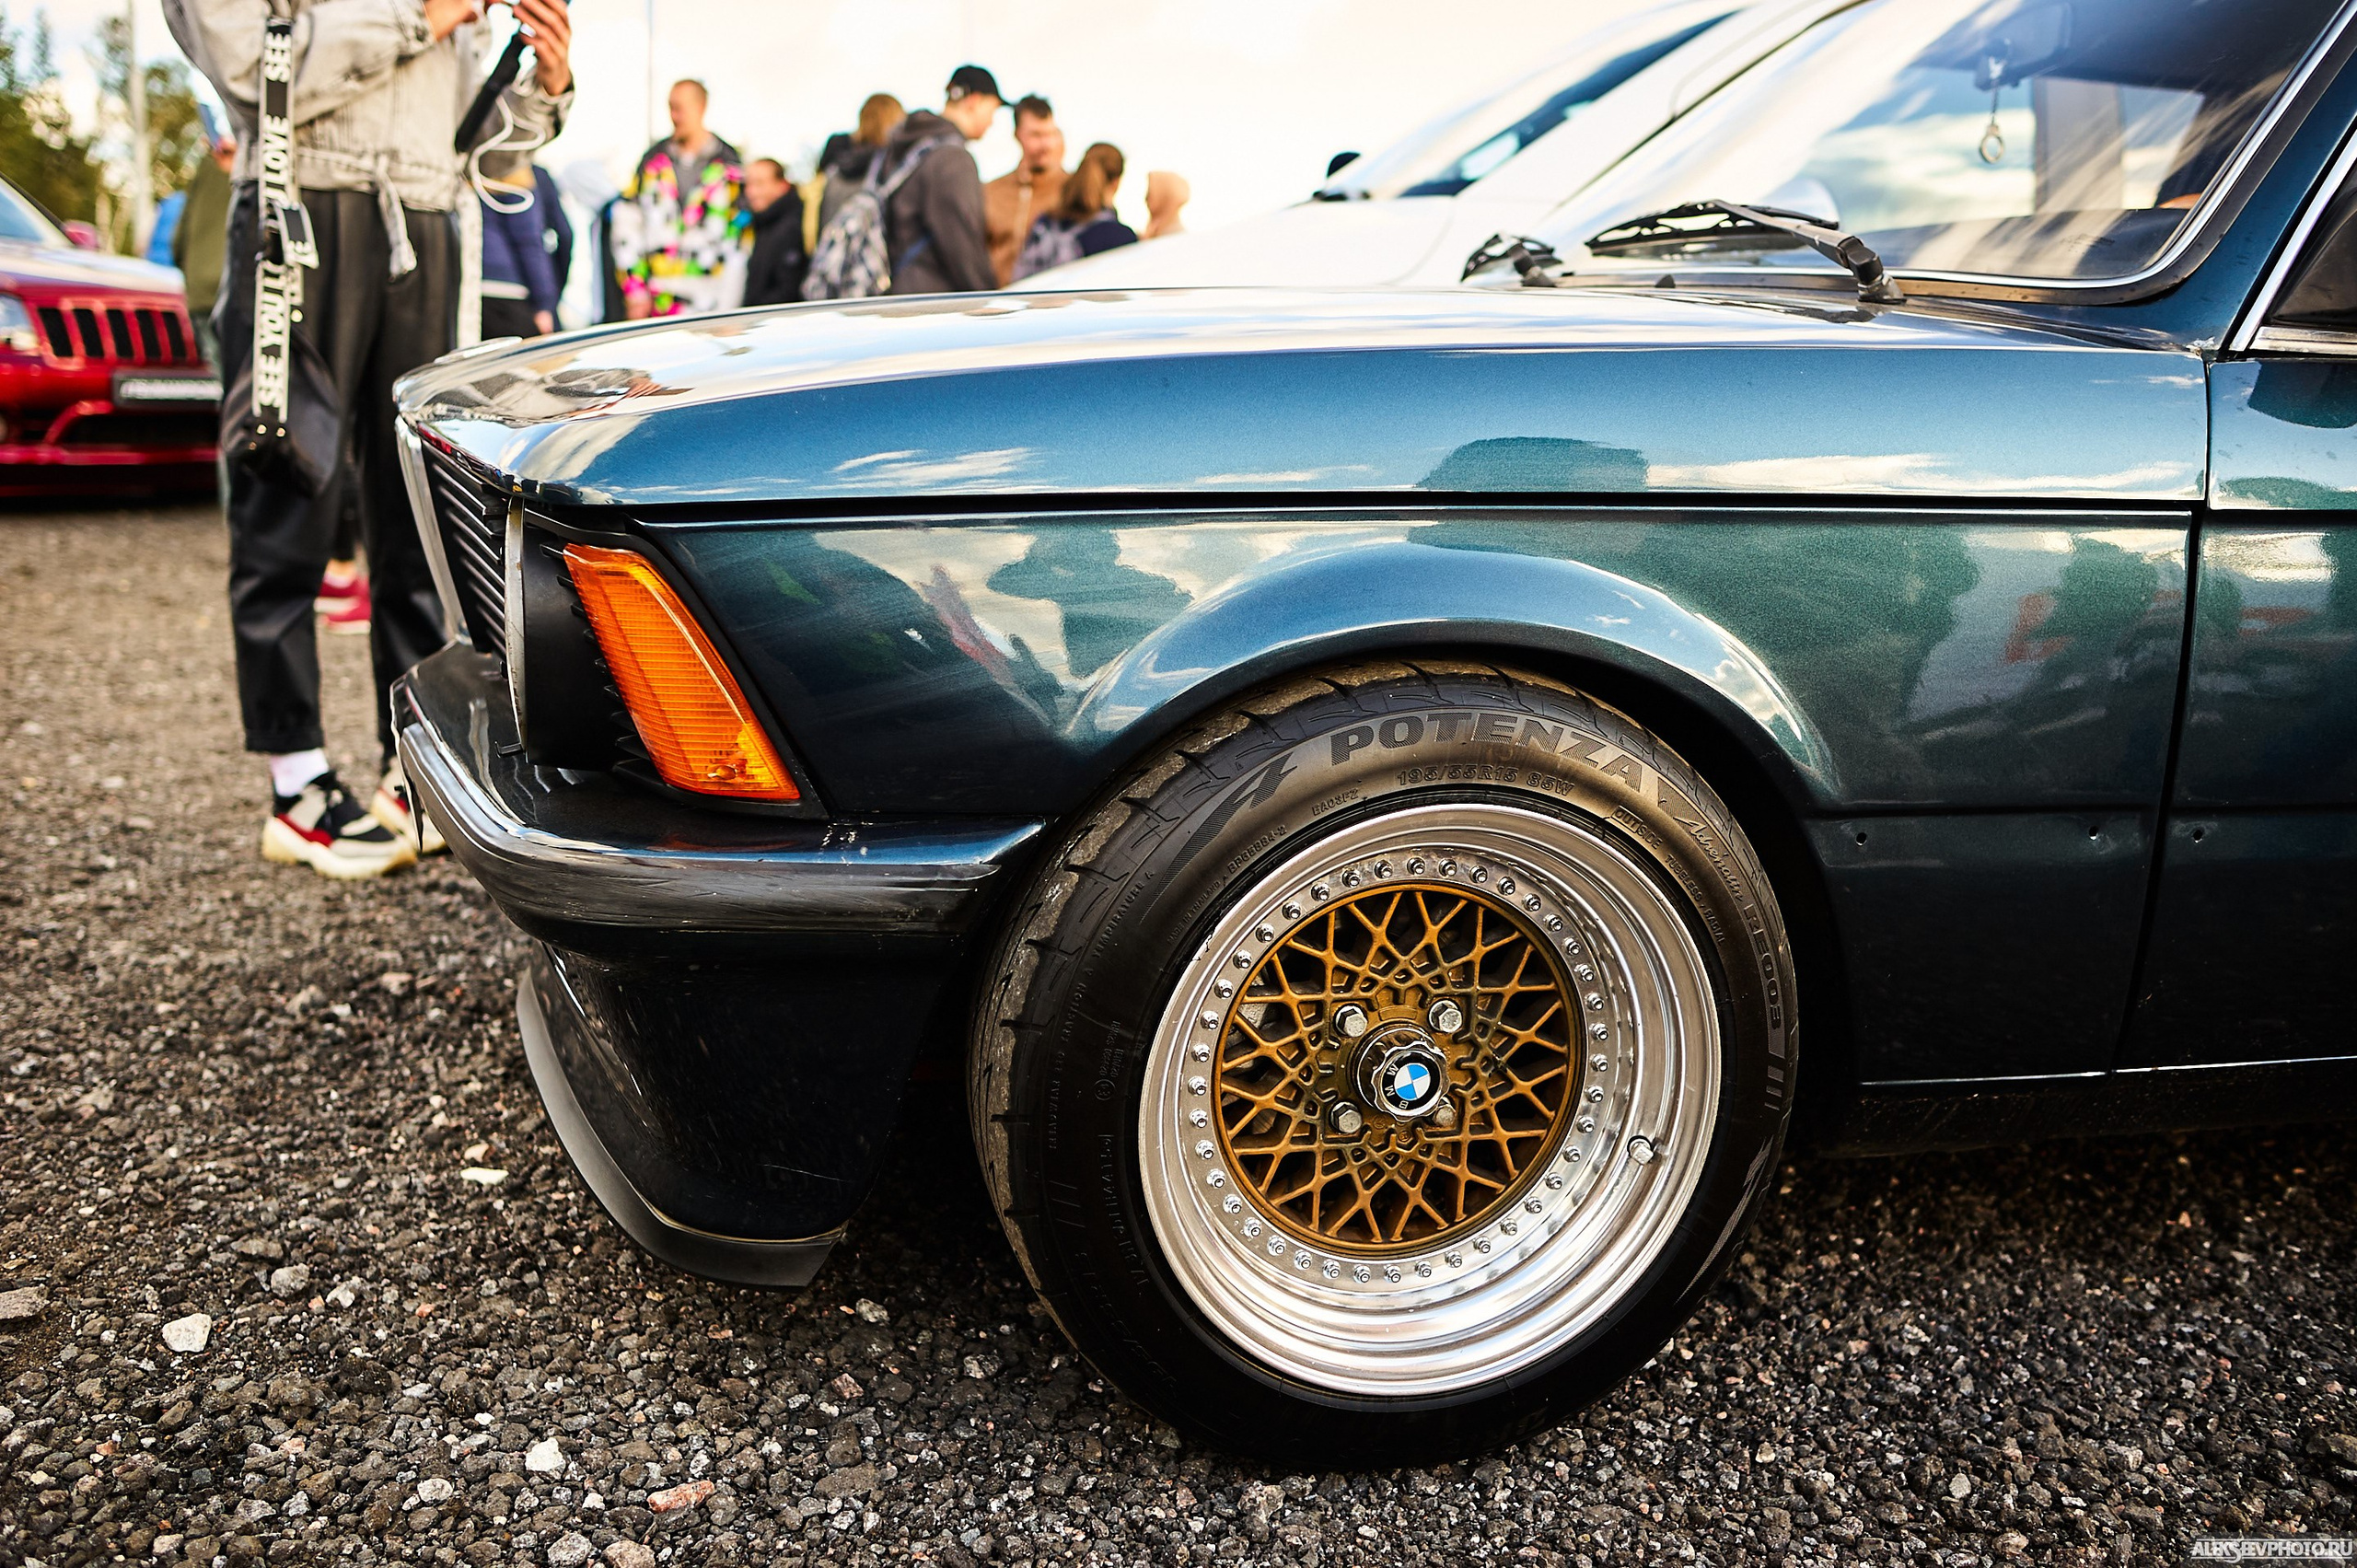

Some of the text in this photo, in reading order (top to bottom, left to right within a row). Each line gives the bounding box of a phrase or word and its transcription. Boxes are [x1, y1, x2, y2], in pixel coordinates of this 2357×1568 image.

[265, 32, 291, 83] SEE
[263, 115, 288, 184] LOVE
[261, 293, 286, 348] YOU
[259, 355, 284, 407] SEE
[1330, 713, 1644, 793] POTENZA
[1397, 764, 1575, 796] 195/55R15 85W
[1665, 855, 1703, 902] TUBELESS
[1385, 1063, 1409, 1109] BMW
